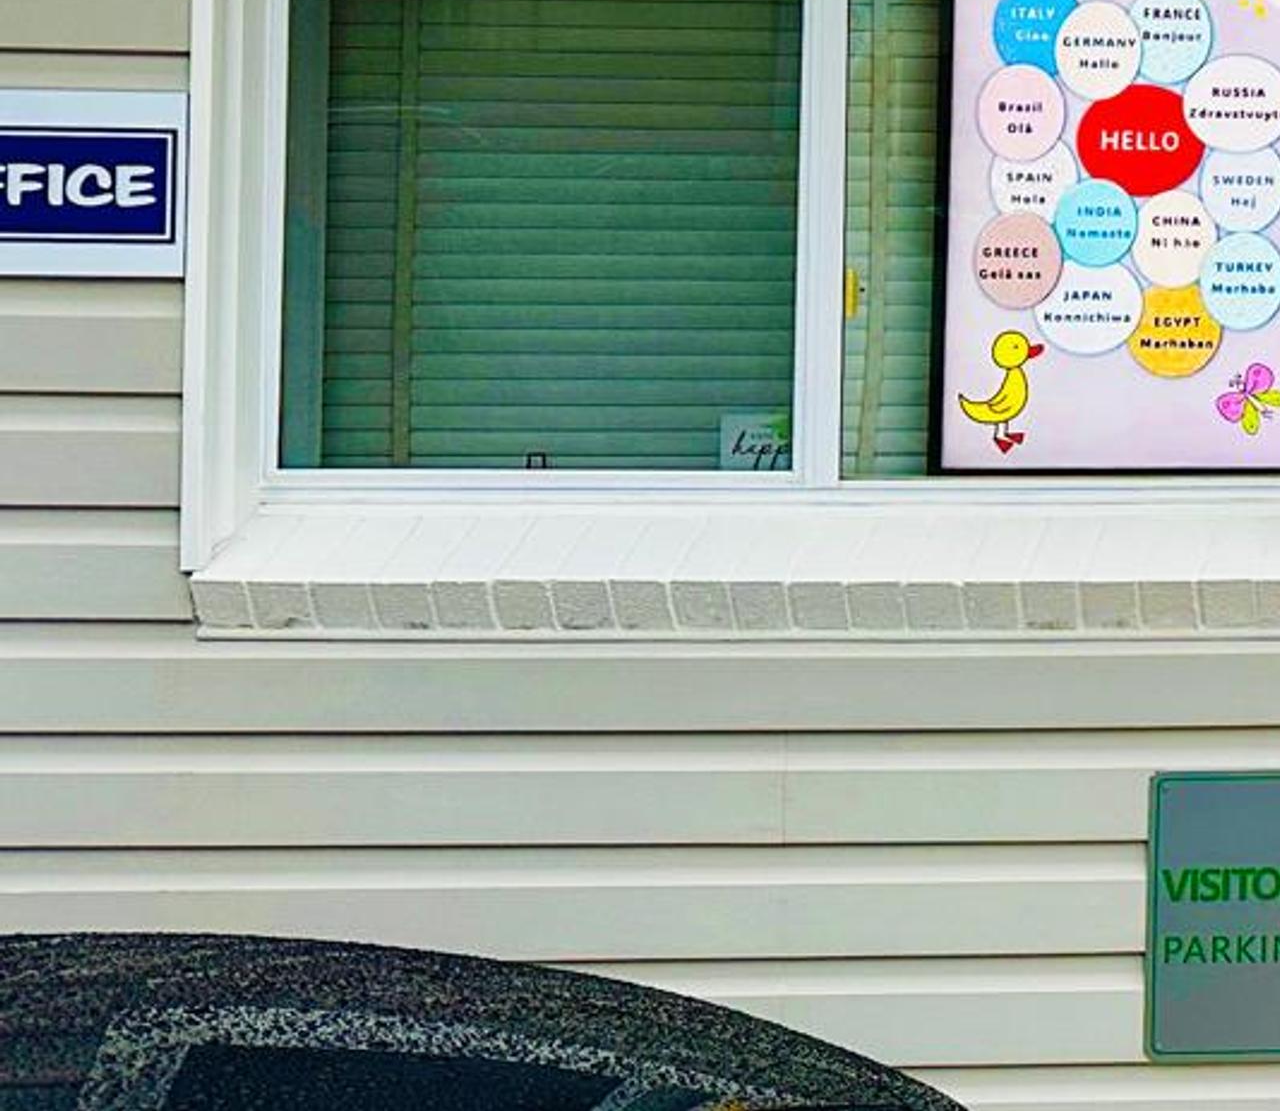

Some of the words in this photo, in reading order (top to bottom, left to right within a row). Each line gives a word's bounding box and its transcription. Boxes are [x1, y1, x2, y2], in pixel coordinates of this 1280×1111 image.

[1010, 6, 1056, 21] ITALY
[1143, 6, 1201, 21] FRANCE
[1014, 28, 1050, 42] Ciao
[1142, 30, 1202, 44] Bonjour
[1062, 36, 1138, 48] GERMANY
[1079, 58, 1120, 70] Hallo
[1211, 87, 1267, 99] RUSSIA
[998, 101, 1044, 113] Brazil
[1100, 131, 1180, 152] HELLO
[1005, 172, 1053, 183] SPAIN
[1212, 174, 1275, 187] SWEDEN
[0, 163, 158, 207] FICE
[1010, 194, 1047, 205] Hola
[1077, 206, 1123, 218] INDIA
[1151, 215, 1201, 227] CHINA
[1066, 228, 1132, 240] Namaste
[981, 246, 1039, 259] GREECE
[1215, 261, 1274, 274] TURKEY
[1062, 289, 1113, 302] JAPAN
[1153, 316, 1201, 328] EGYPT
